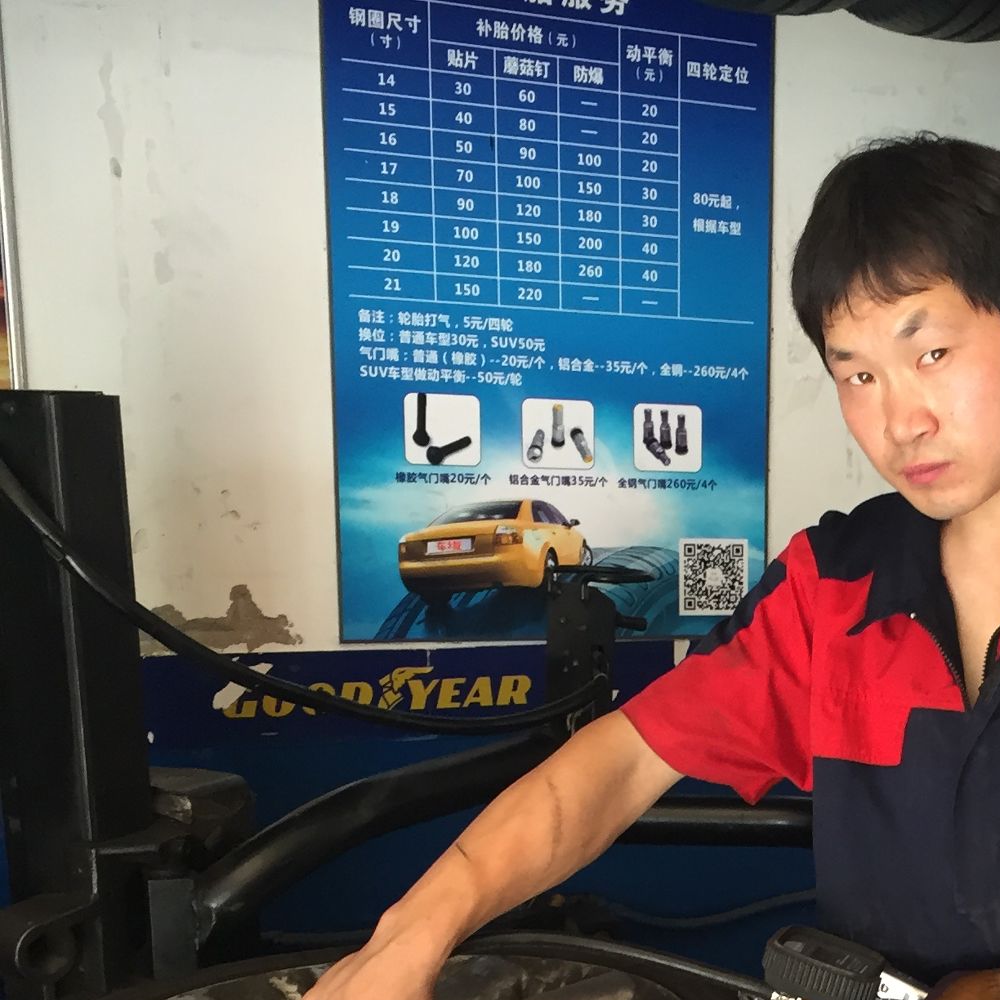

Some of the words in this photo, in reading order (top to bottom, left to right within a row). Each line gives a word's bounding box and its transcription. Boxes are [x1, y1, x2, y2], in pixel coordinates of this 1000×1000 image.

[348, 7, 421, 34] 钢圈尺寸
[447, 49, 479, 70] 贴片
[503, 56, 550, 79] 蘑菇钉
[626, 45, 673, 67] 动平衡
[573, 65, 604, 85] 防爆
[686, 61, 750, 84] 四轮定位
[377, 72, 396, 87] 14
[454, 81, 472, 96] 30
[518, 89, 536, 104] 60
[641, 103, 658, 118] 20
[378, 102, 397, 117] 15
[454, 111, 473, 125] 40
[519, 118, 536, 132] 80
[641, 131, 658, 146] 20
[379, 131, 398, 146] 16
[455, 140, 473, 154] 50
[519, 146, 537, 161] 90
[577, 153, 602, 168] 100
[641, 159, 658, 173] 20
[380, 161, 398, 175] 17
[456, 168, 474, 183] 70
[515, 175, 541, 190] 100
[577, 181, 602, 196] 150
[642, 187, 658, 201] 30
[381, 190, 399, 205] 18
[456, 197, 475, 212] 90
[516, 203, 541, 218] 120
[578, 209, 602, 223] 180
[642, 214, 658, 228] 30
[382, 219, 400, 234] 19
[453, 226, 479, 241] 100
[517, 231, 542, 246] 150
[578, 236, 603, 251] 200
[641, 242, 658, 256] 40
[693, 217, 742, 236] 根据车型
[383, 248, 401, 262] 20
[454, 254, 480, 269] 120
[517, 259, 542, 274] 180
[578, 264, 603, 278] 260
[642, 269, 658, 283] 40
[383, 277, 402, 292] 21
[455, 282, 481, 297] 150
[517, 287, 543, 301] 220
